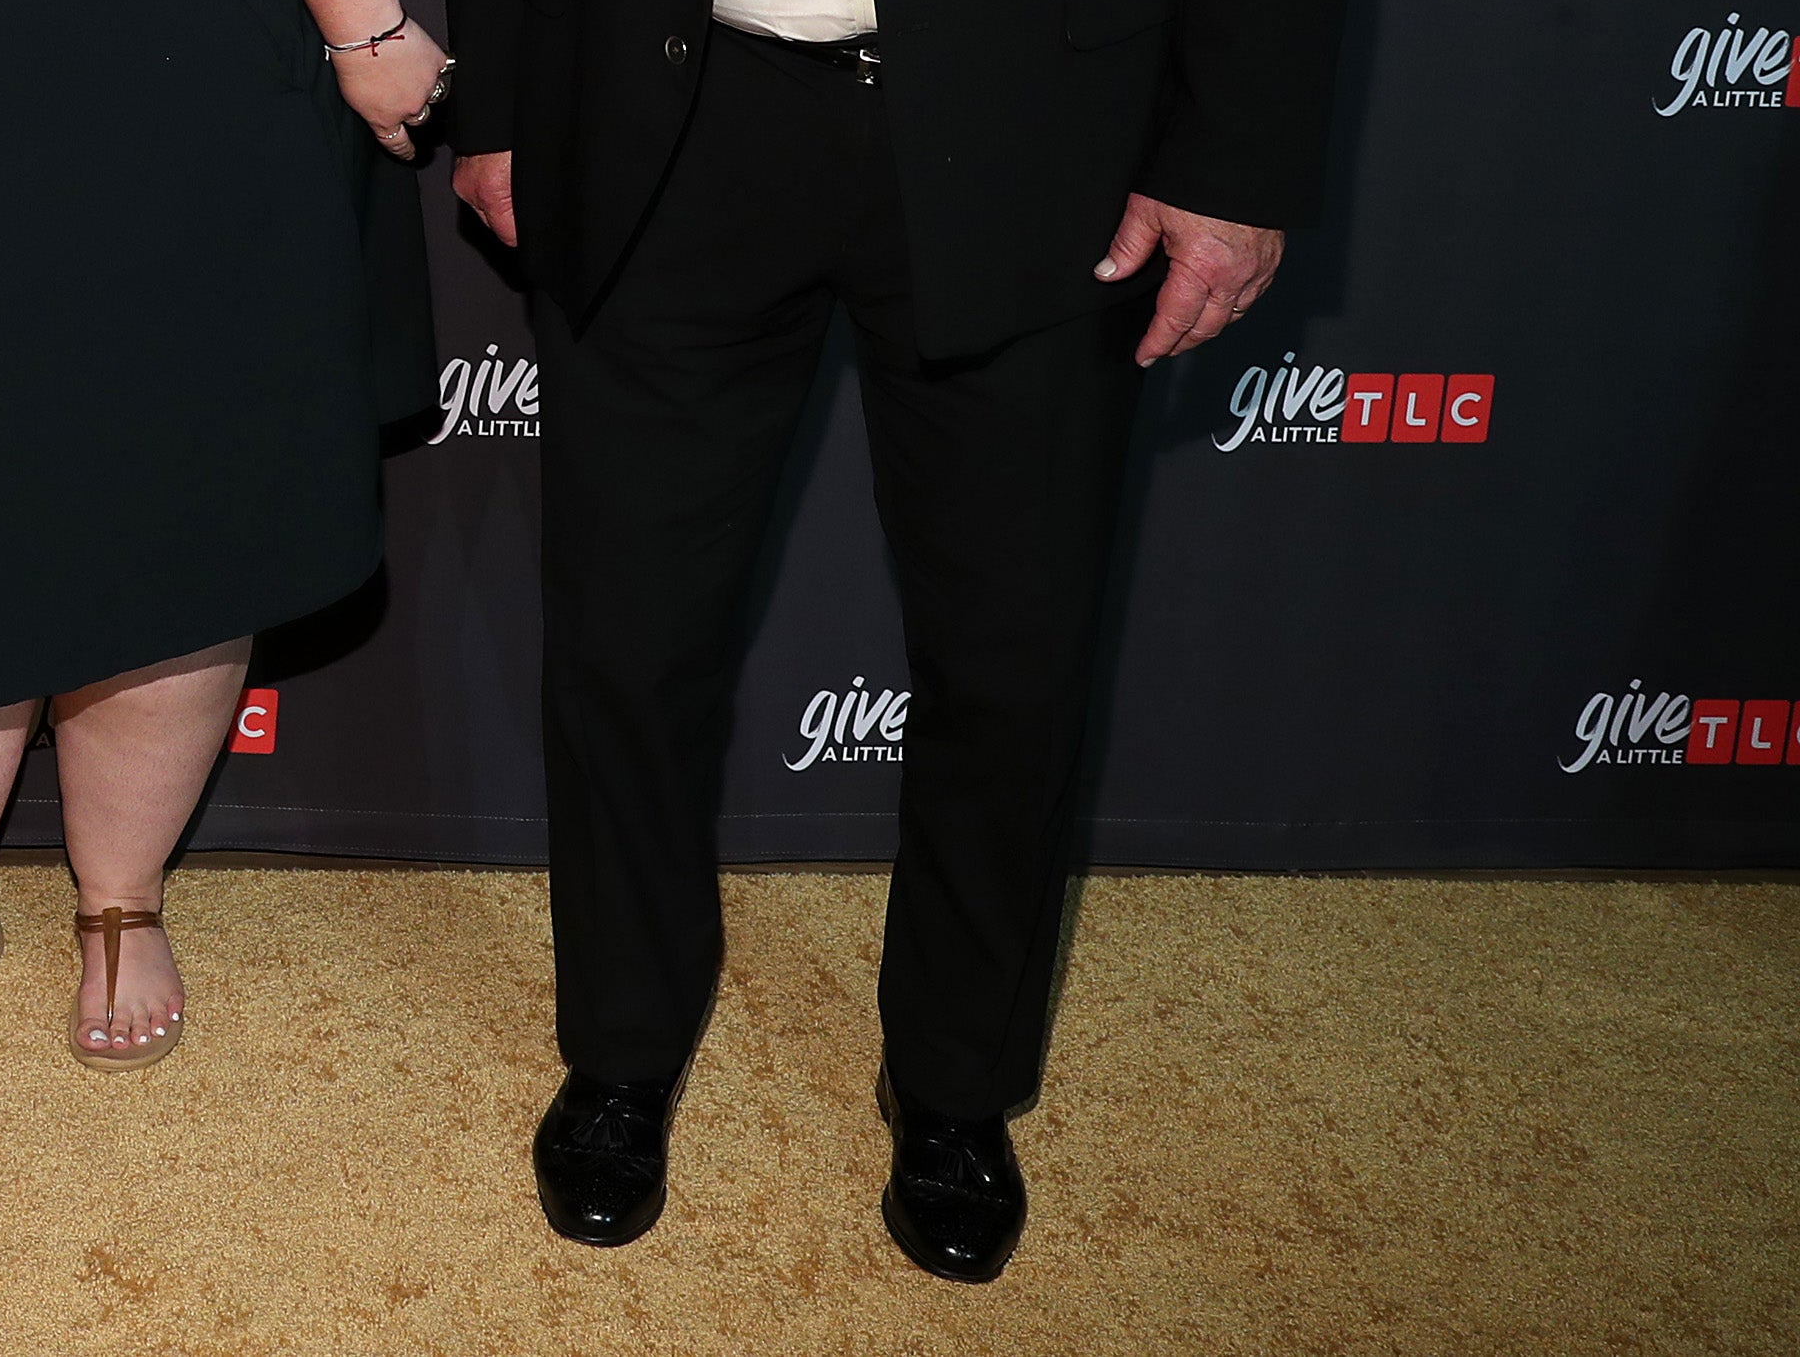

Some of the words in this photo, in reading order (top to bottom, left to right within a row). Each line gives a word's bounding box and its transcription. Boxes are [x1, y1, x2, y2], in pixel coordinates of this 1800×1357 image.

[1652, 12, 1795, 117] give
[1691, 90, 1708, 107] A
[1713, 90, 1783, 108] LITTLE
[427, 343, 540, 445] give
[1211, 351, 1351, 452] give
[1353, 392, 1482, 426] TLC
[457, 419, 473, 436] A
[1250, 426, 1266, 443] A
[1271, 426, 1339, 444] LITTLE
[782, 675, 913, 771] give
[1557, 679, 1694, 773] give
[1699, 717, 1800, 749] TL
[821, 746, 837, 762] A
[1596, 749, 1612, 764] A
[1616, 749, 1684, 764] LITTLE
